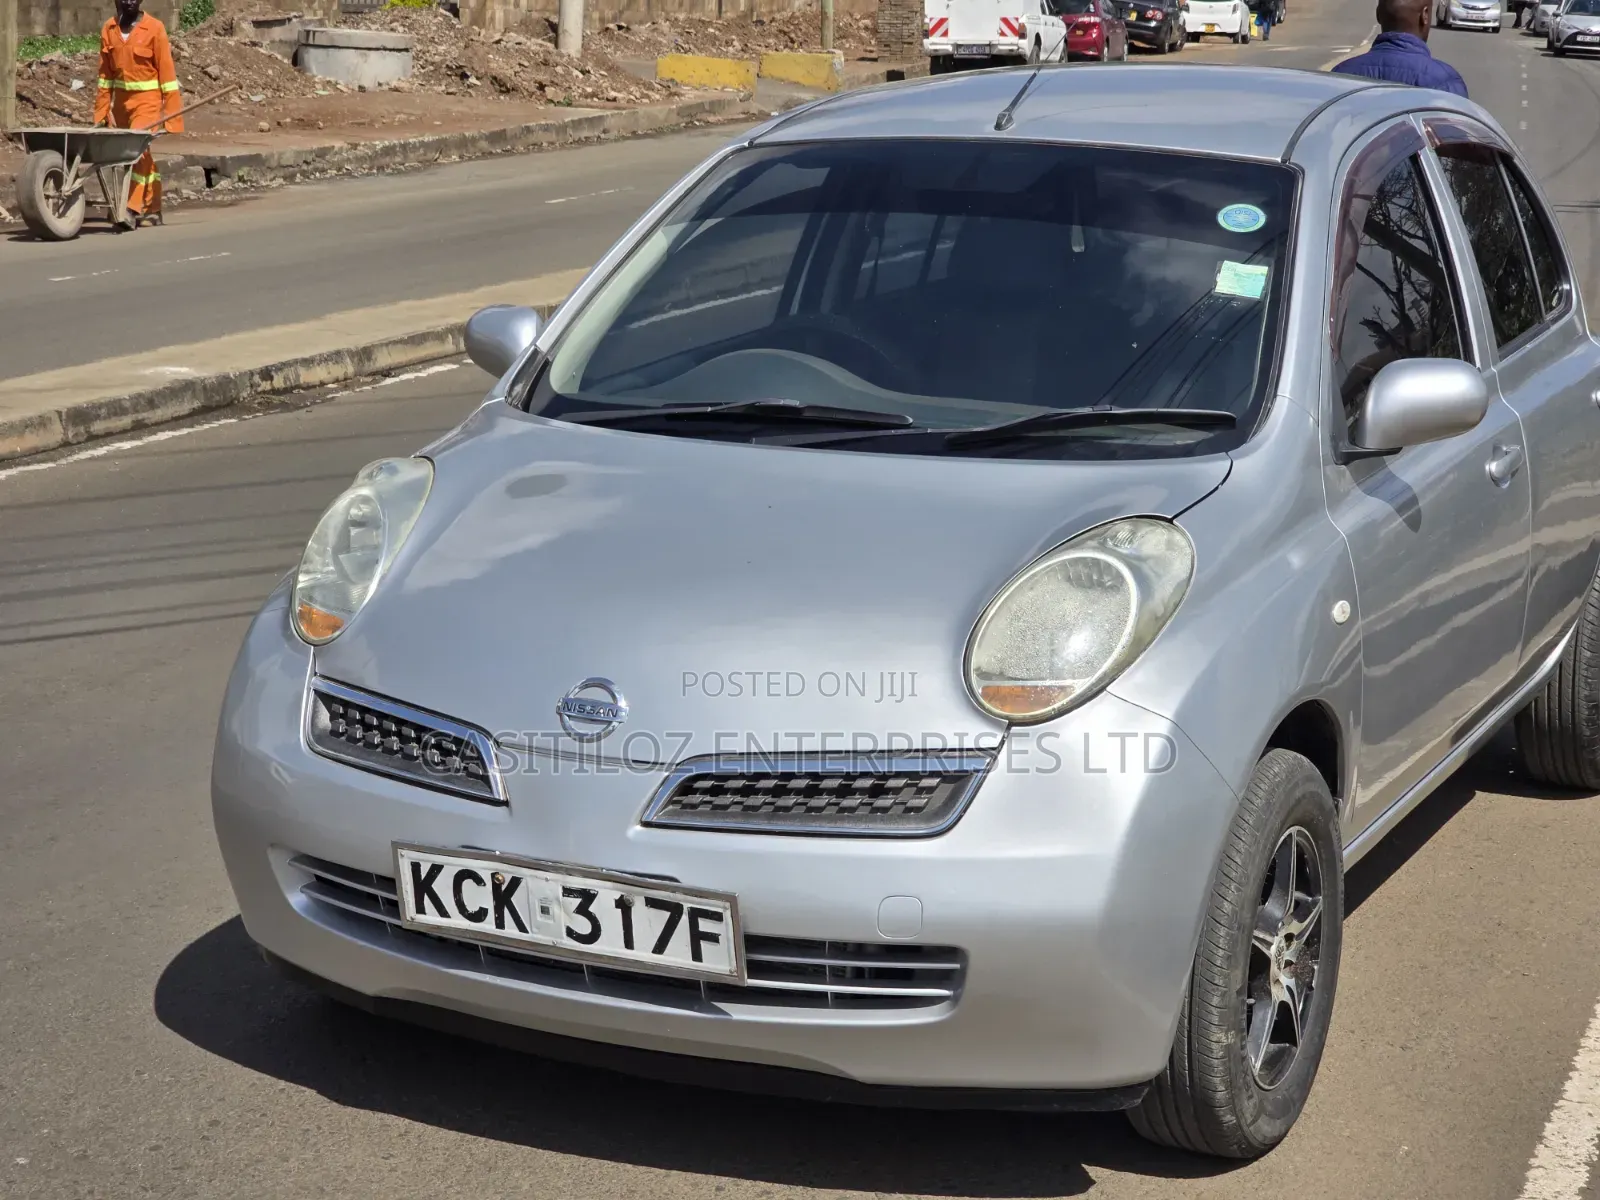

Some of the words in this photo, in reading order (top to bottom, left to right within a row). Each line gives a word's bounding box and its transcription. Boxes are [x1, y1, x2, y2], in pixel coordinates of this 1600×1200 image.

[562, 701, 618, 718] NISSAN
[409, 860, 530, 934] KCK
[561, 885, 724, 963] 317F
